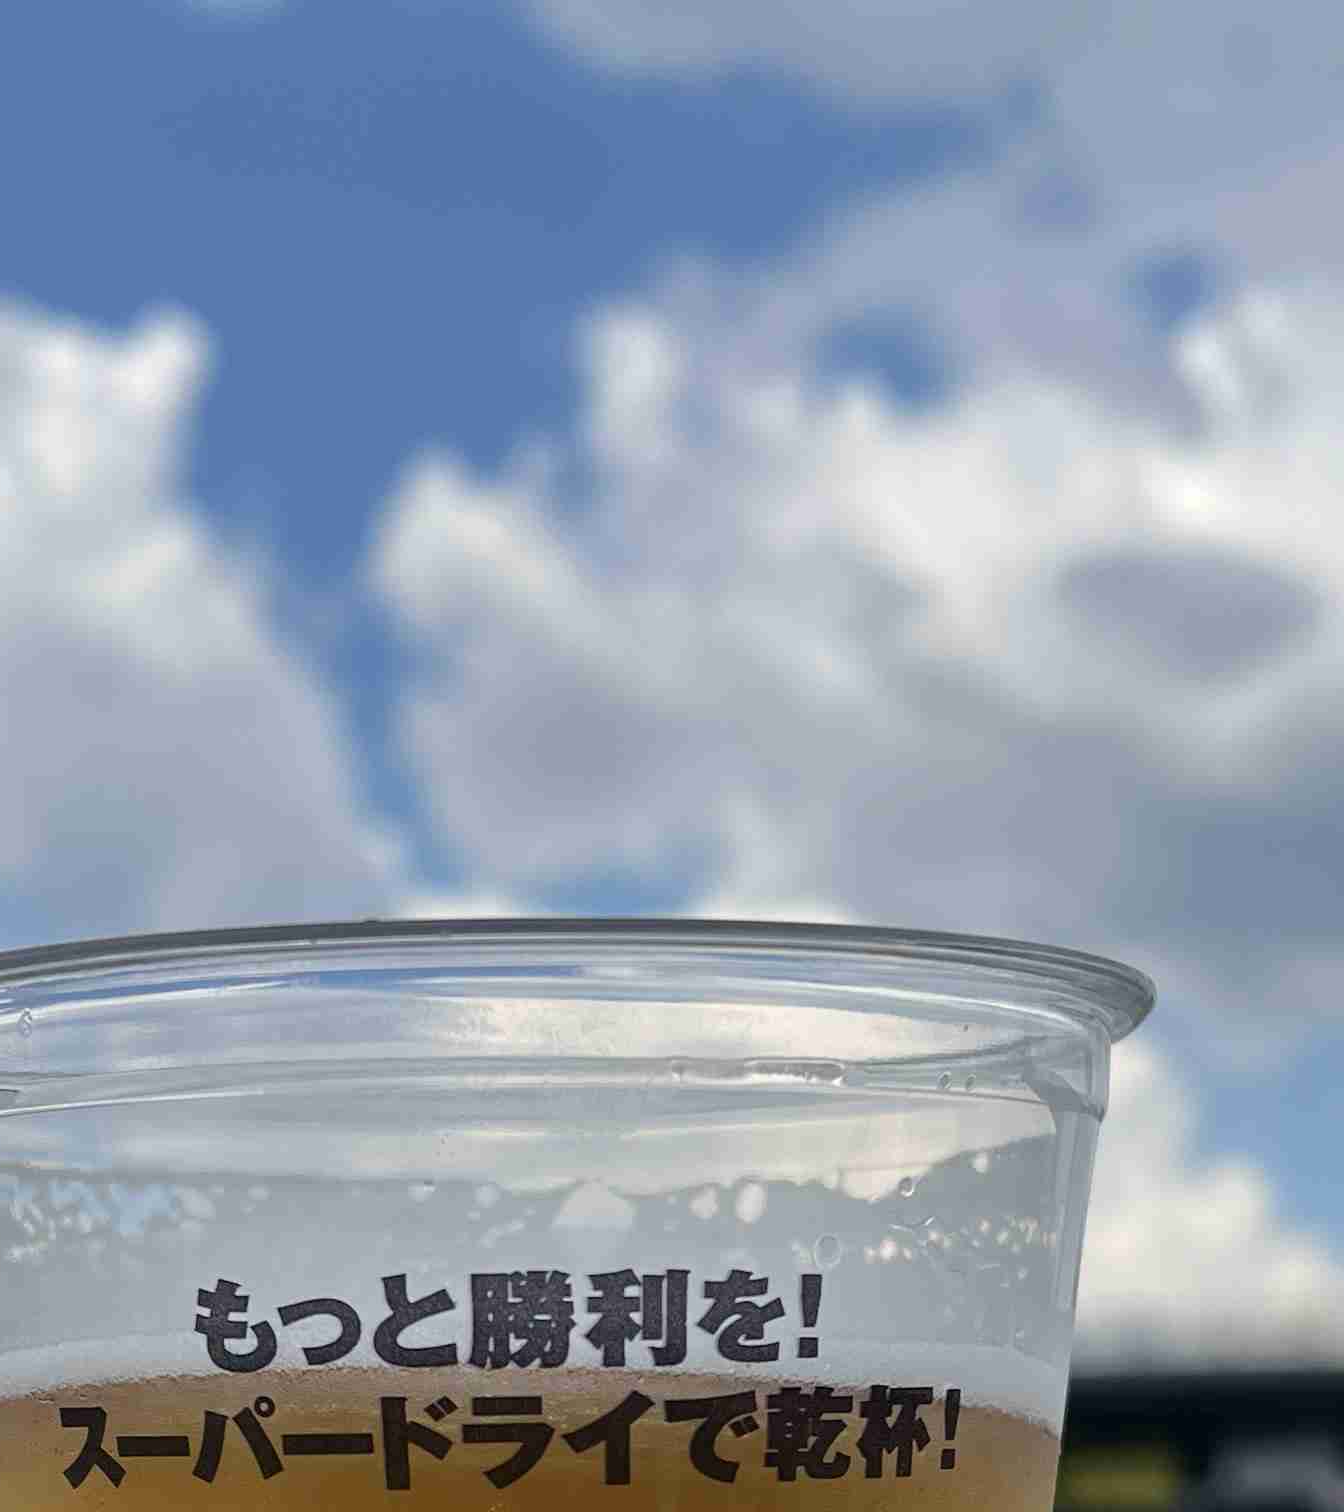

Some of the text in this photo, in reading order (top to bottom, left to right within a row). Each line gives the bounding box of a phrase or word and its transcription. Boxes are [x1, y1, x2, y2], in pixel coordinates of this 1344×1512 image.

[193, 1267, 824, 1373] もっと勝利を!
[57, 1385, 964, 1491] スーパードライで乾杯!
